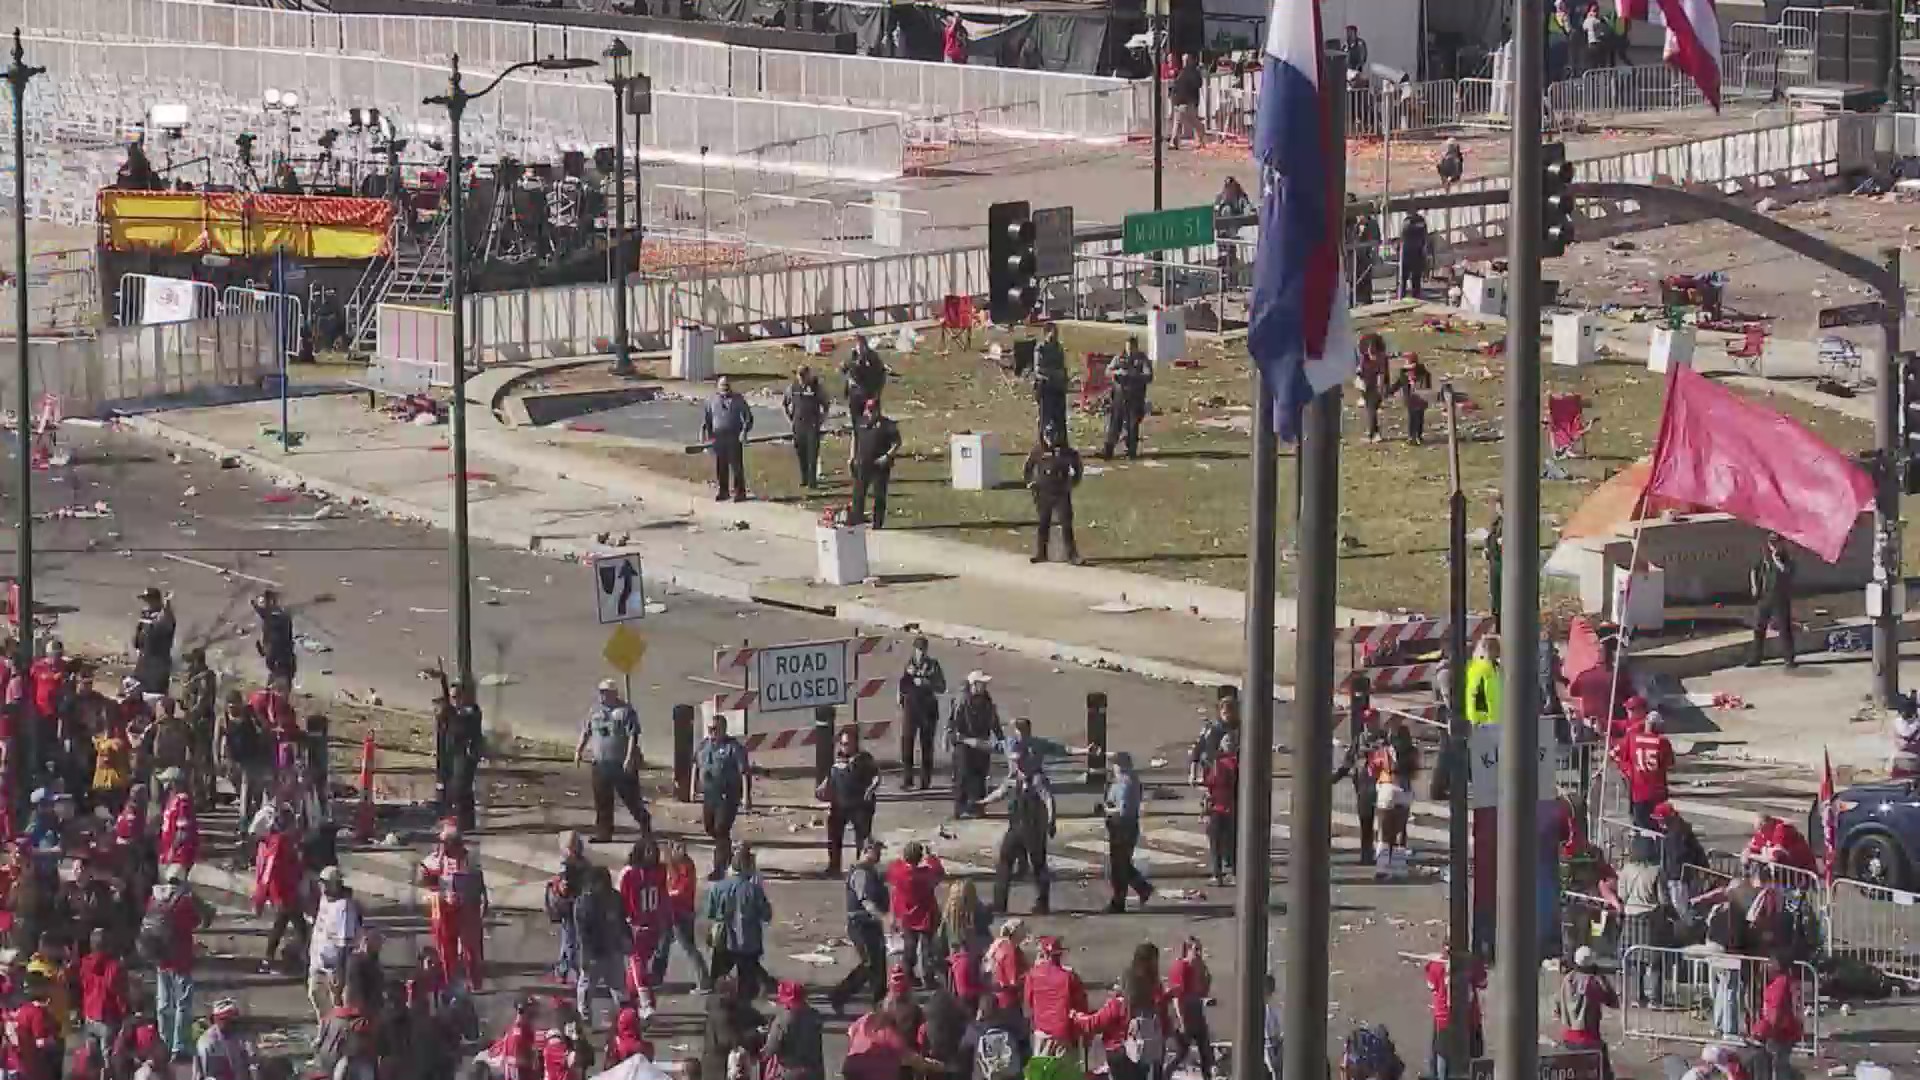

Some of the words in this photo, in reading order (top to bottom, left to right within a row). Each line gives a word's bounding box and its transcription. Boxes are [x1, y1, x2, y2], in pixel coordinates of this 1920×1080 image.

[1135, 223, 1174, 244] Main
[776, 653, 827, 675] ROAD
[766, 678, 838, 702] CLOSED
[1636, 748, 1658, 772] 15
[640, 887, 659, 912] 10
